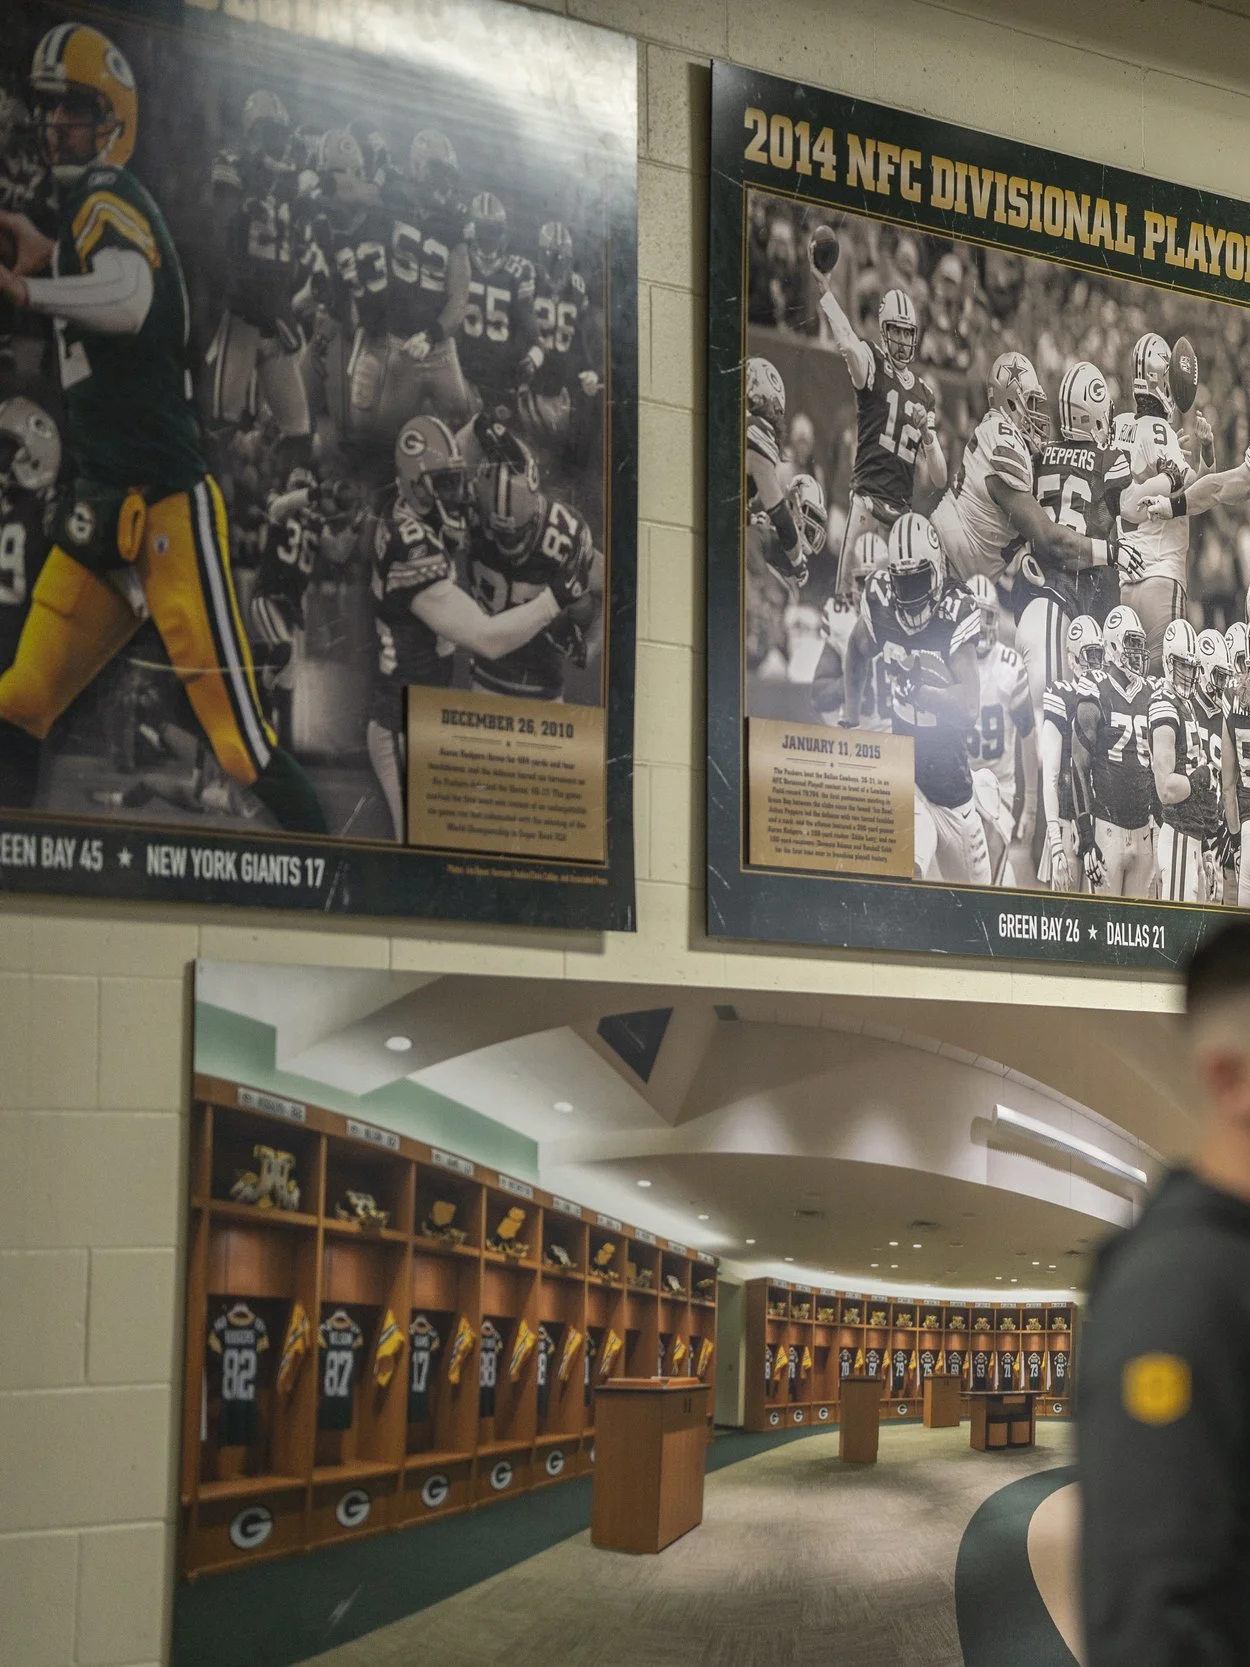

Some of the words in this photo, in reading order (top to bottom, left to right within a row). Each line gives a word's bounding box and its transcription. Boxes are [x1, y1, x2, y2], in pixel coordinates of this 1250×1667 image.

[744, 107, 837, 182] 2014
[847, 133, 922, 203] NFC
[930, 155, 1135, 256] DIVISIONAL
[1152, 423, 1168, 447] 9
[1042, 447, 1096, 472] PEPPERS
[441, 709, 514, 733] DECEMBER
[541, 721, 574, 739] 2010
[782, 734, 835, 756] JANUARY
[855, 742, 881, 760] 2015
[0, 833, 36, 868] EEN
[41, 836, 77, 870] BAY
[79, 840, 103, 872] 45
[147, 846, 187, 878] NEW
[191, 848, 238, 882] YORK
[241, 853, 301, 887] GIANTS
[305, 858, 326, 889] 17
[998, 913, 1038, 940] GREEN
[1040, 916, 1063, 941] BAY
[1065, 918, 1080, 942] 26
[1106, 921, 1150, 948] DALLAS
[1152, 925, 1165, 949] 21
[222, 1348, 257, 1401] 82
[324, 1350, 353, 1398] 87
[411, 1351, 430, 1392] 17
[335, 1489, 371, 1528] G
[422, 1474, 449, 1507] G
[229, 1506, 273, 1550] G
